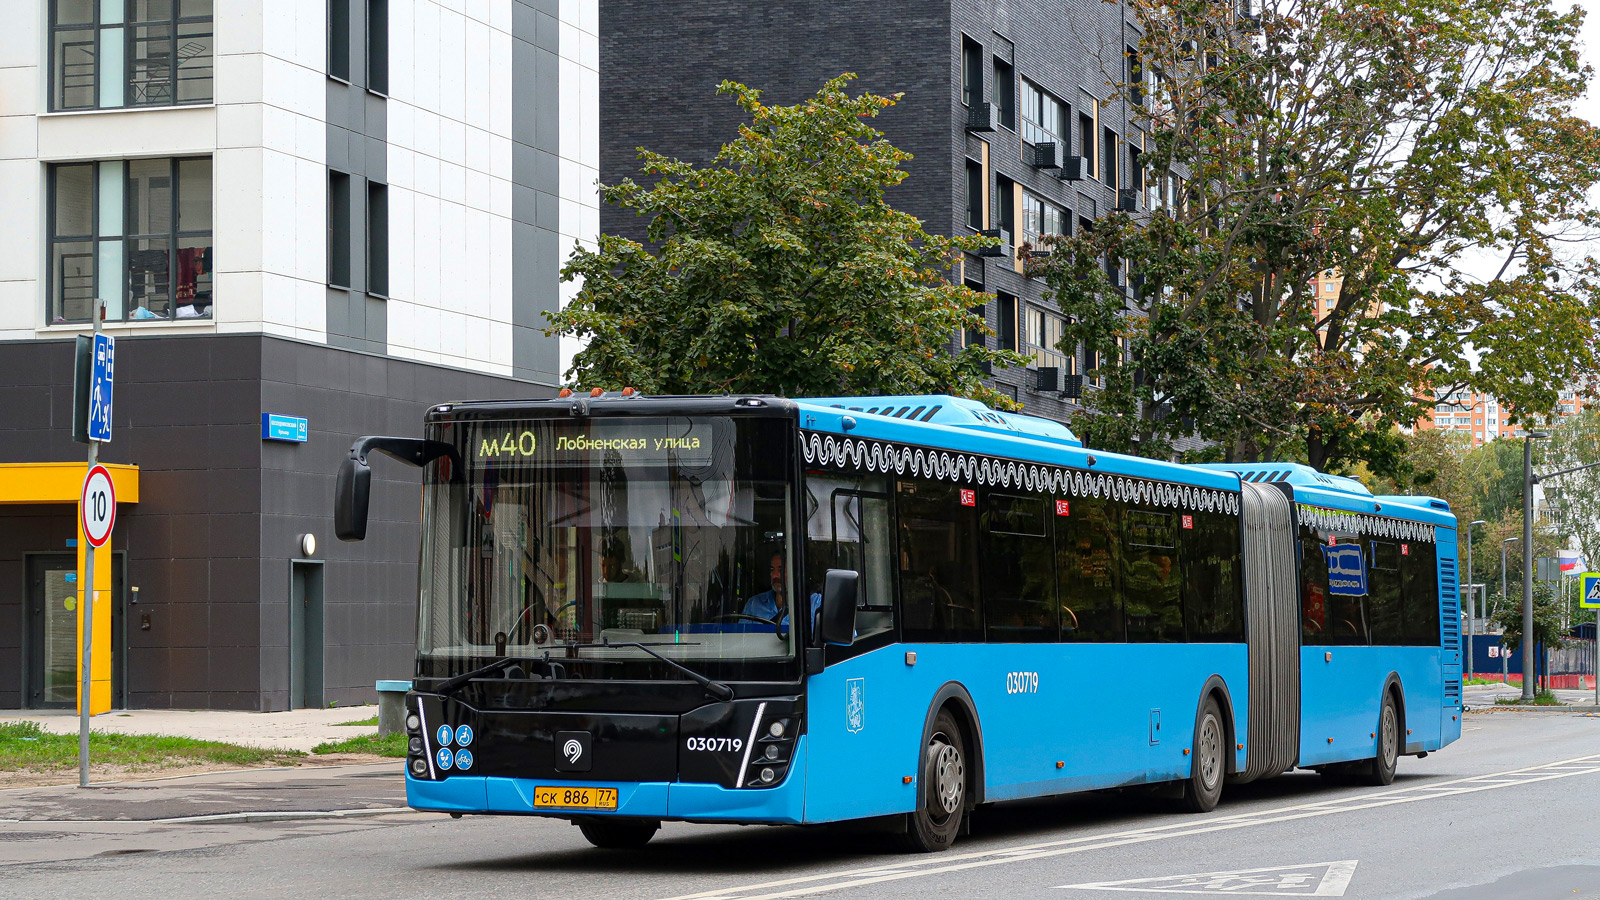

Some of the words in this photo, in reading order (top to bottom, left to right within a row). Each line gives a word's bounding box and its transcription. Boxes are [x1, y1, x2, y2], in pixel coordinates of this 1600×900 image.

[556, 434, 646, 451] Лобненская
[654, 436, 701, 451] улица
[91, 490, 107, 522] 10
[1006, 671, 1039, 695] 030719
[686, 737, 743, 752] 030719
[563, 789, 590, 805] 886
[598, 789, 612, 802] 77
